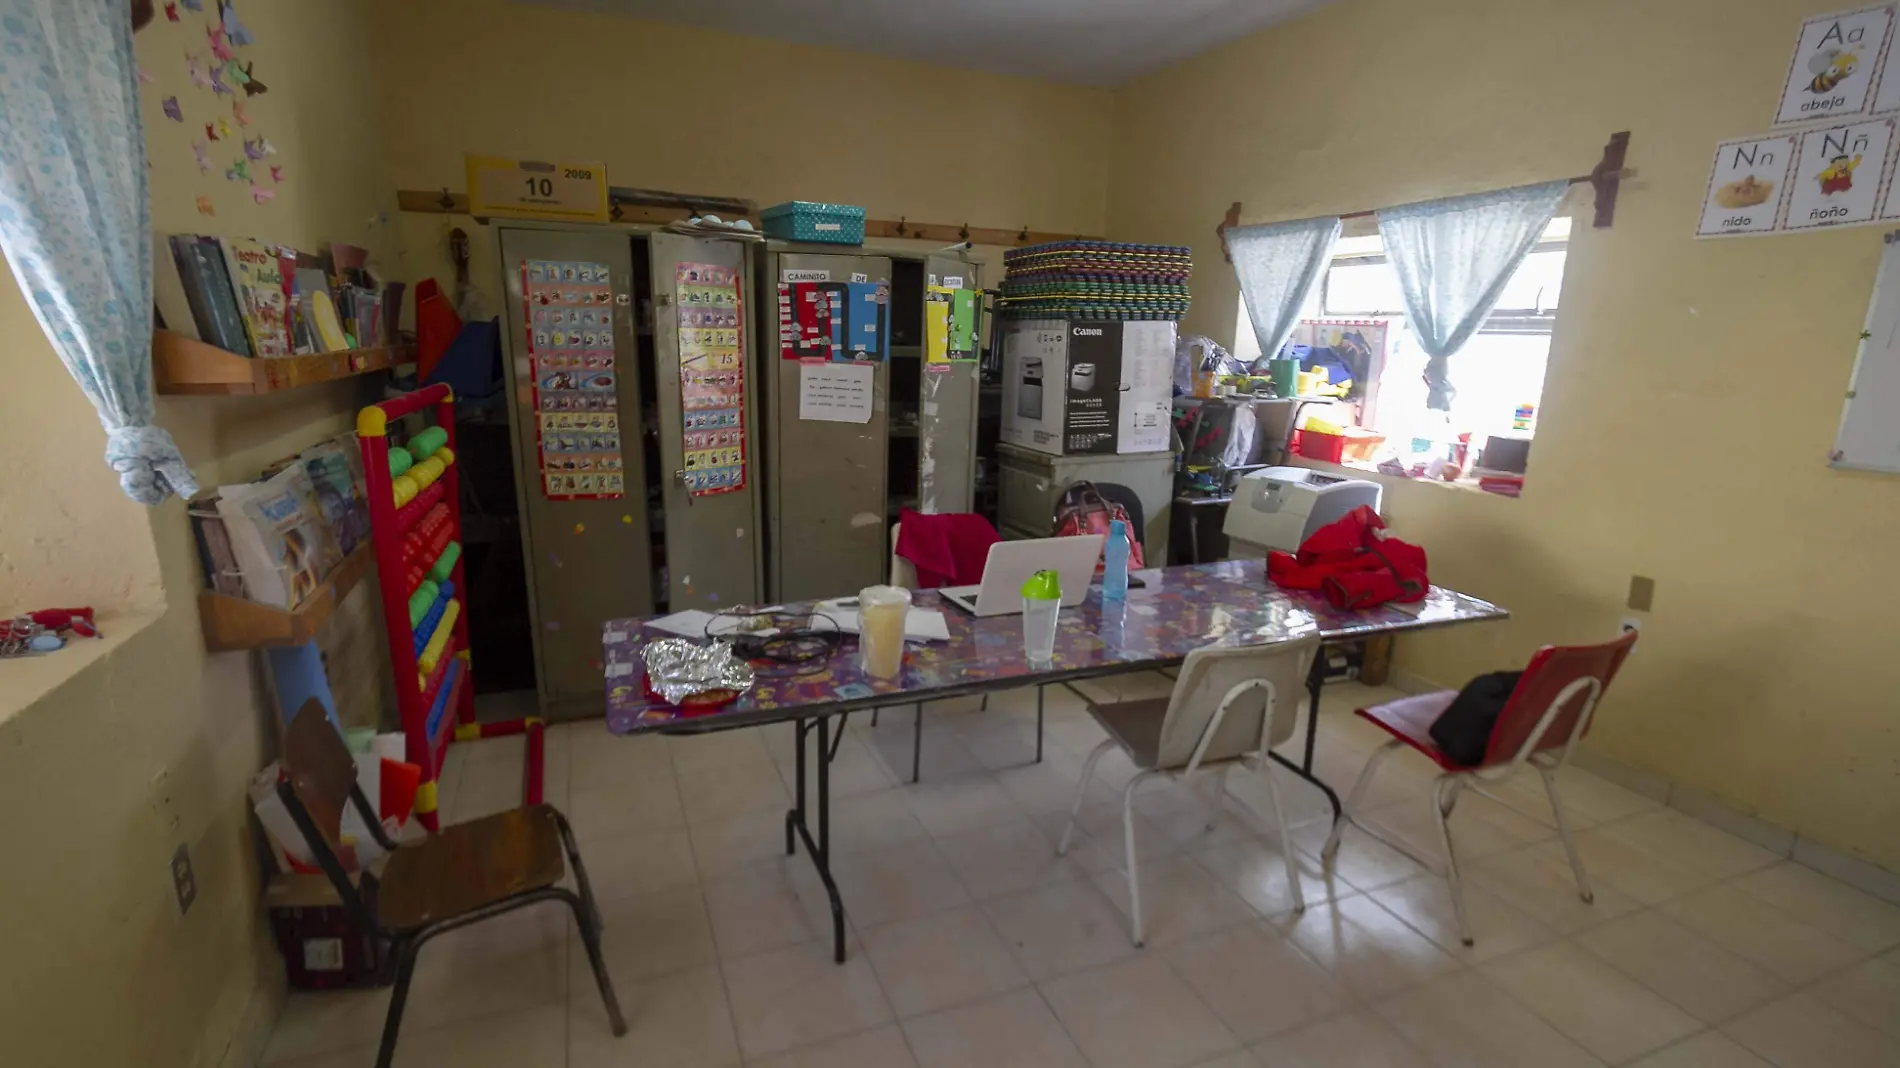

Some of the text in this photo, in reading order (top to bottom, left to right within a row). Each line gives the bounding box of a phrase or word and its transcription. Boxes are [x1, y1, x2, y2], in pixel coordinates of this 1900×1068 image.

[1817, 21, 1865, 49] Aa
[1801, 96, 1845, 111] abeja
[1733, 144, 1774, 169] Nn
[564, 168, 592, 180] 2009
[526, 177, 553, 197] 10
[1809, 207, 1848, 219] ñoño
[1722, 215, 1752, 227] nido
[855, 275, 866, 283] DE
[1073, 327, 1102, 336] Canon
[721, 353, 733, 364] 15
